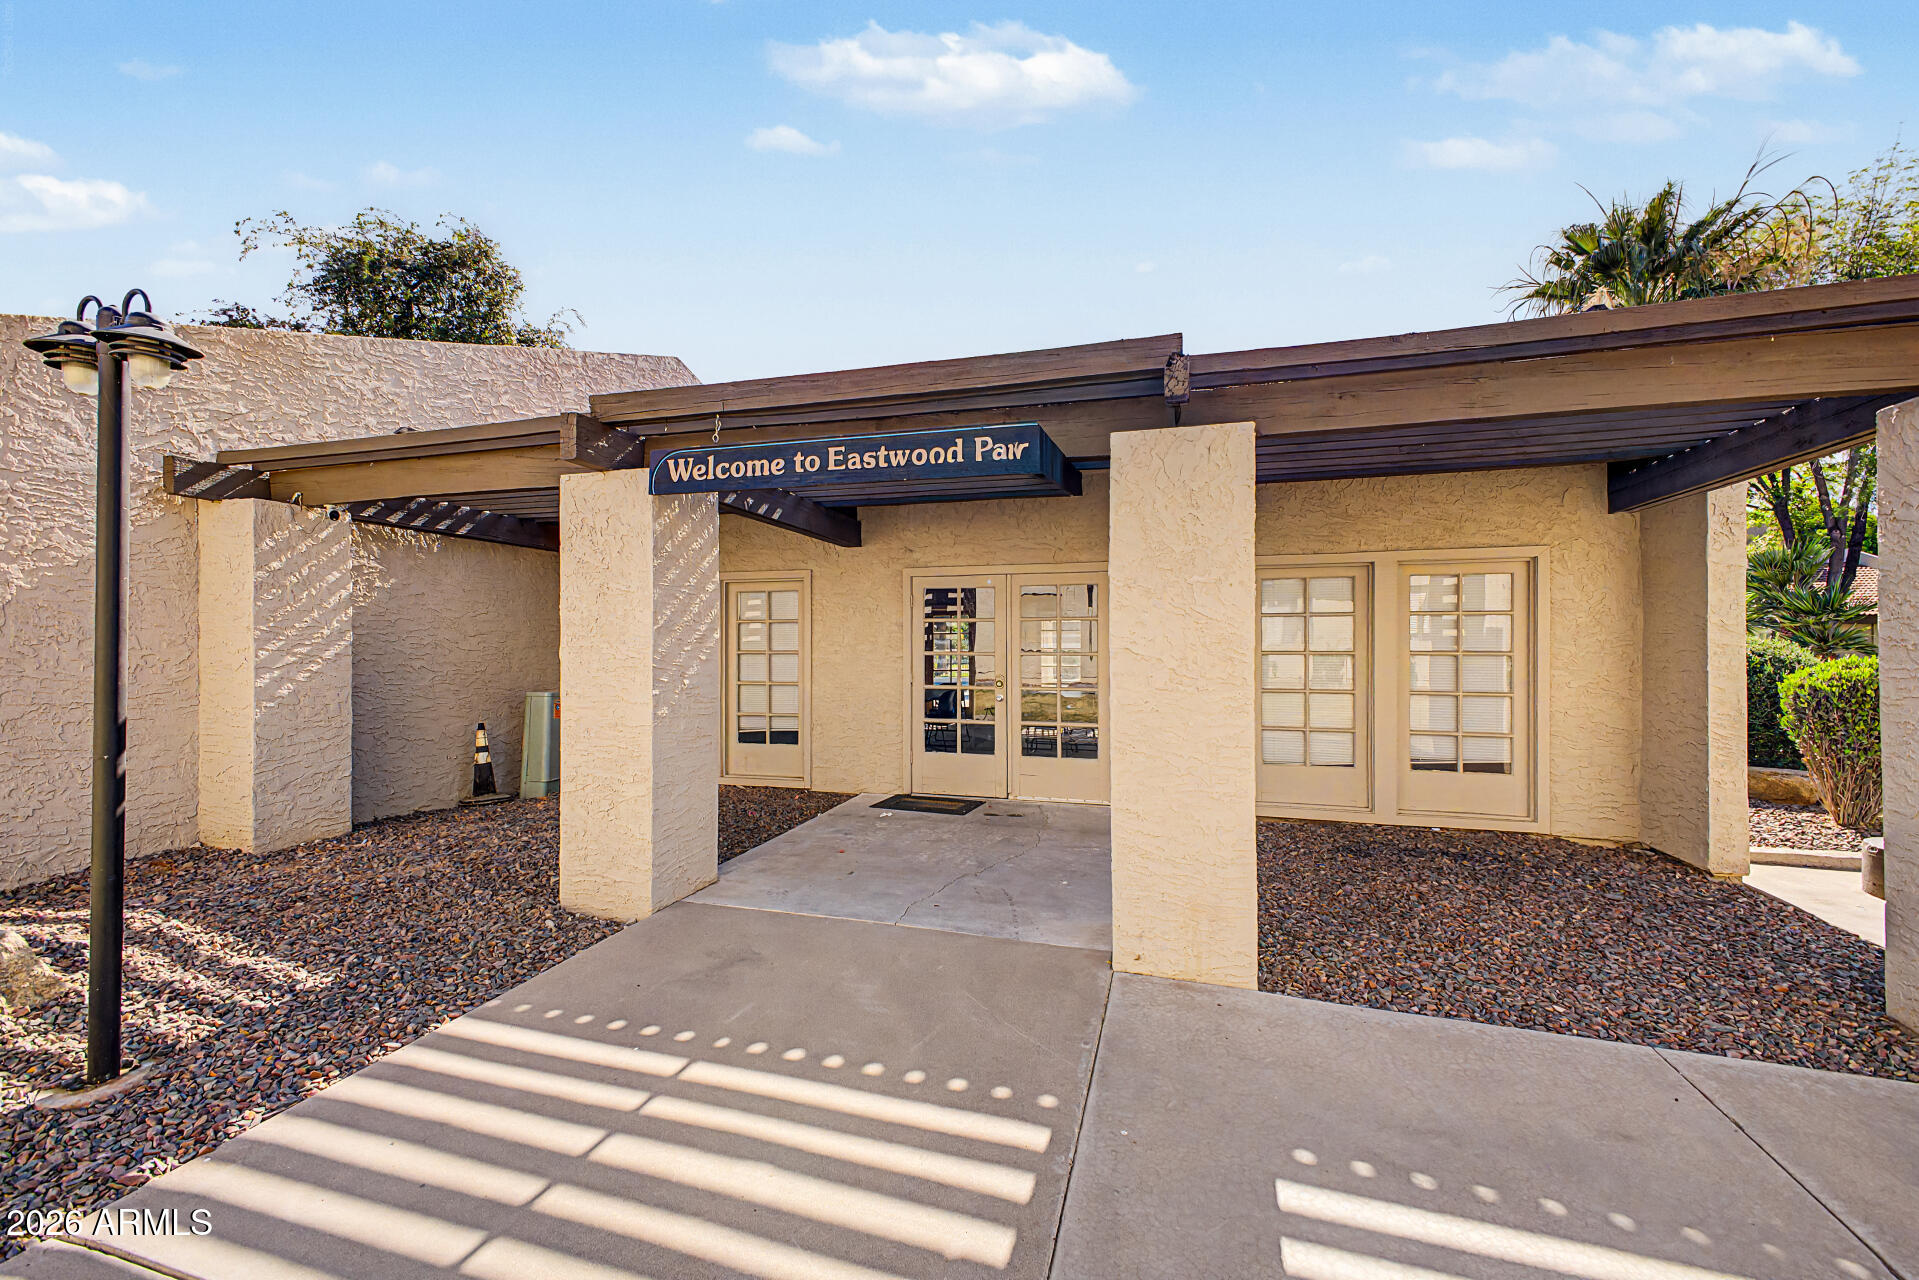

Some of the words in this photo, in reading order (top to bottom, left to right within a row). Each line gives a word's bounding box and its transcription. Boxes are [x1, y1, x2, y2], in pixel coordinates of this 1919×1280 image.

[667, 454, 785, 483] Welcome
[793, 451, 821, 473] to
[827, 438, 965, 471] Eastwood
